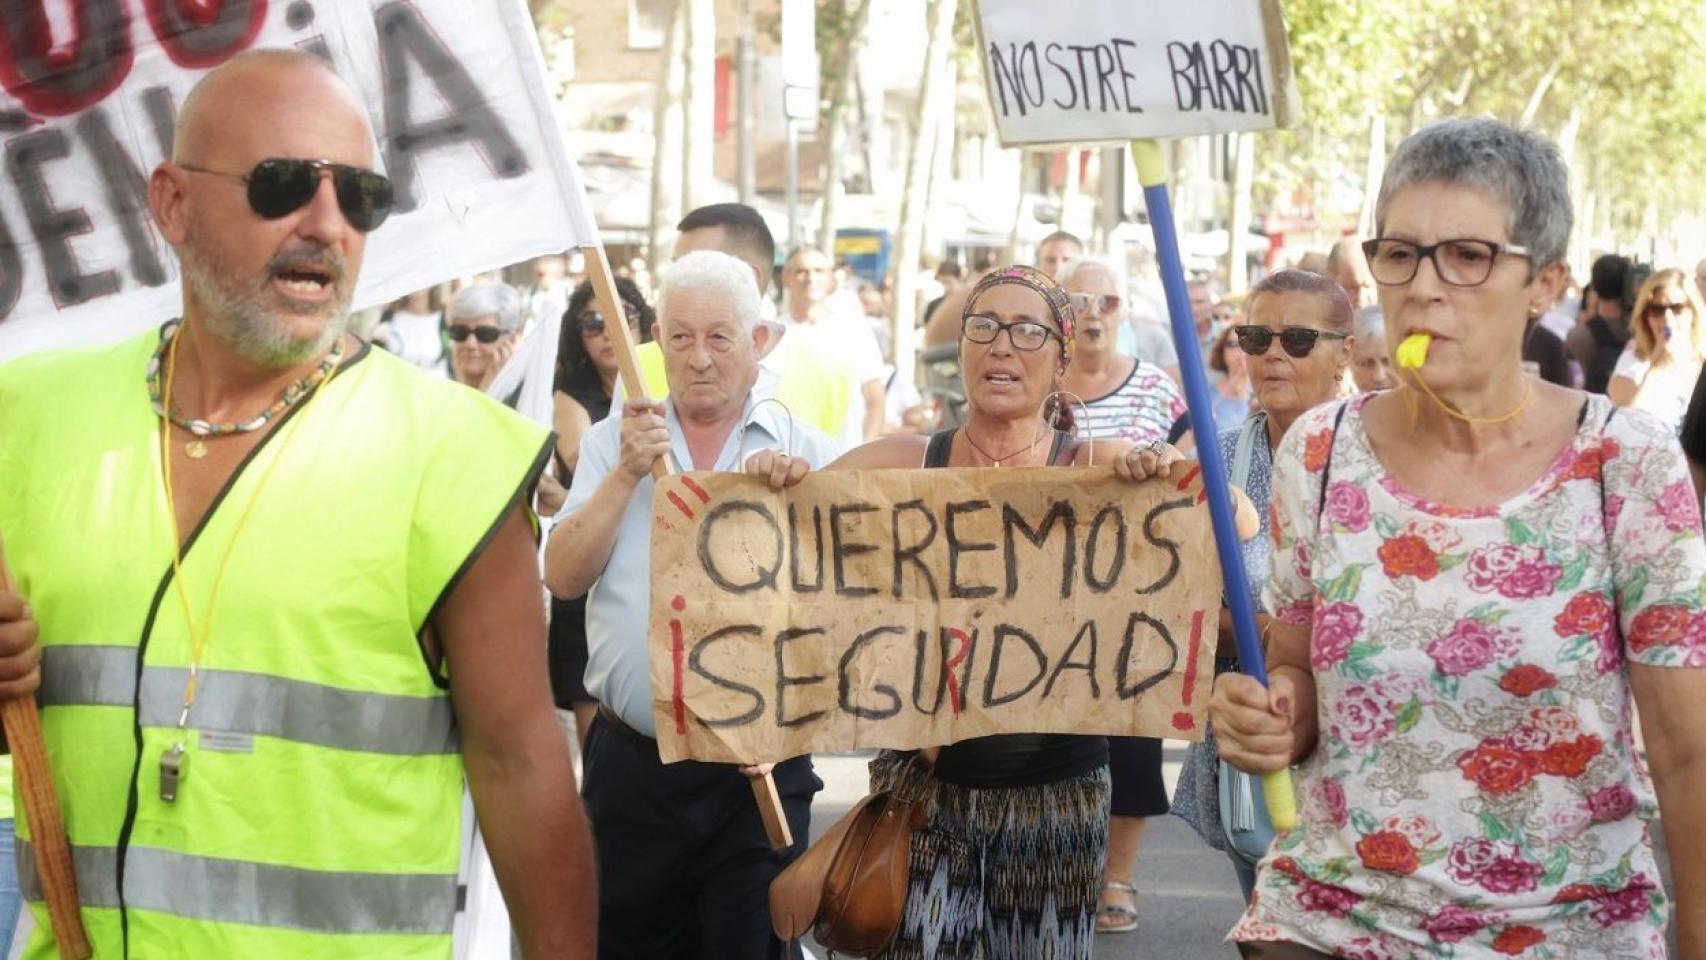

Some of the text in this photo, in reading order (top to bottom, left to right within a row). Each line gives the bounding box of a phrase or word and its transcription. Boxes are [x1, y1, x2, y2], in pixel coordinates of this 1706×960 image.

[991, 38, 1270, 117] NOSTRE BARRI
[698, 498, 1196, 604] QUEREMOS
